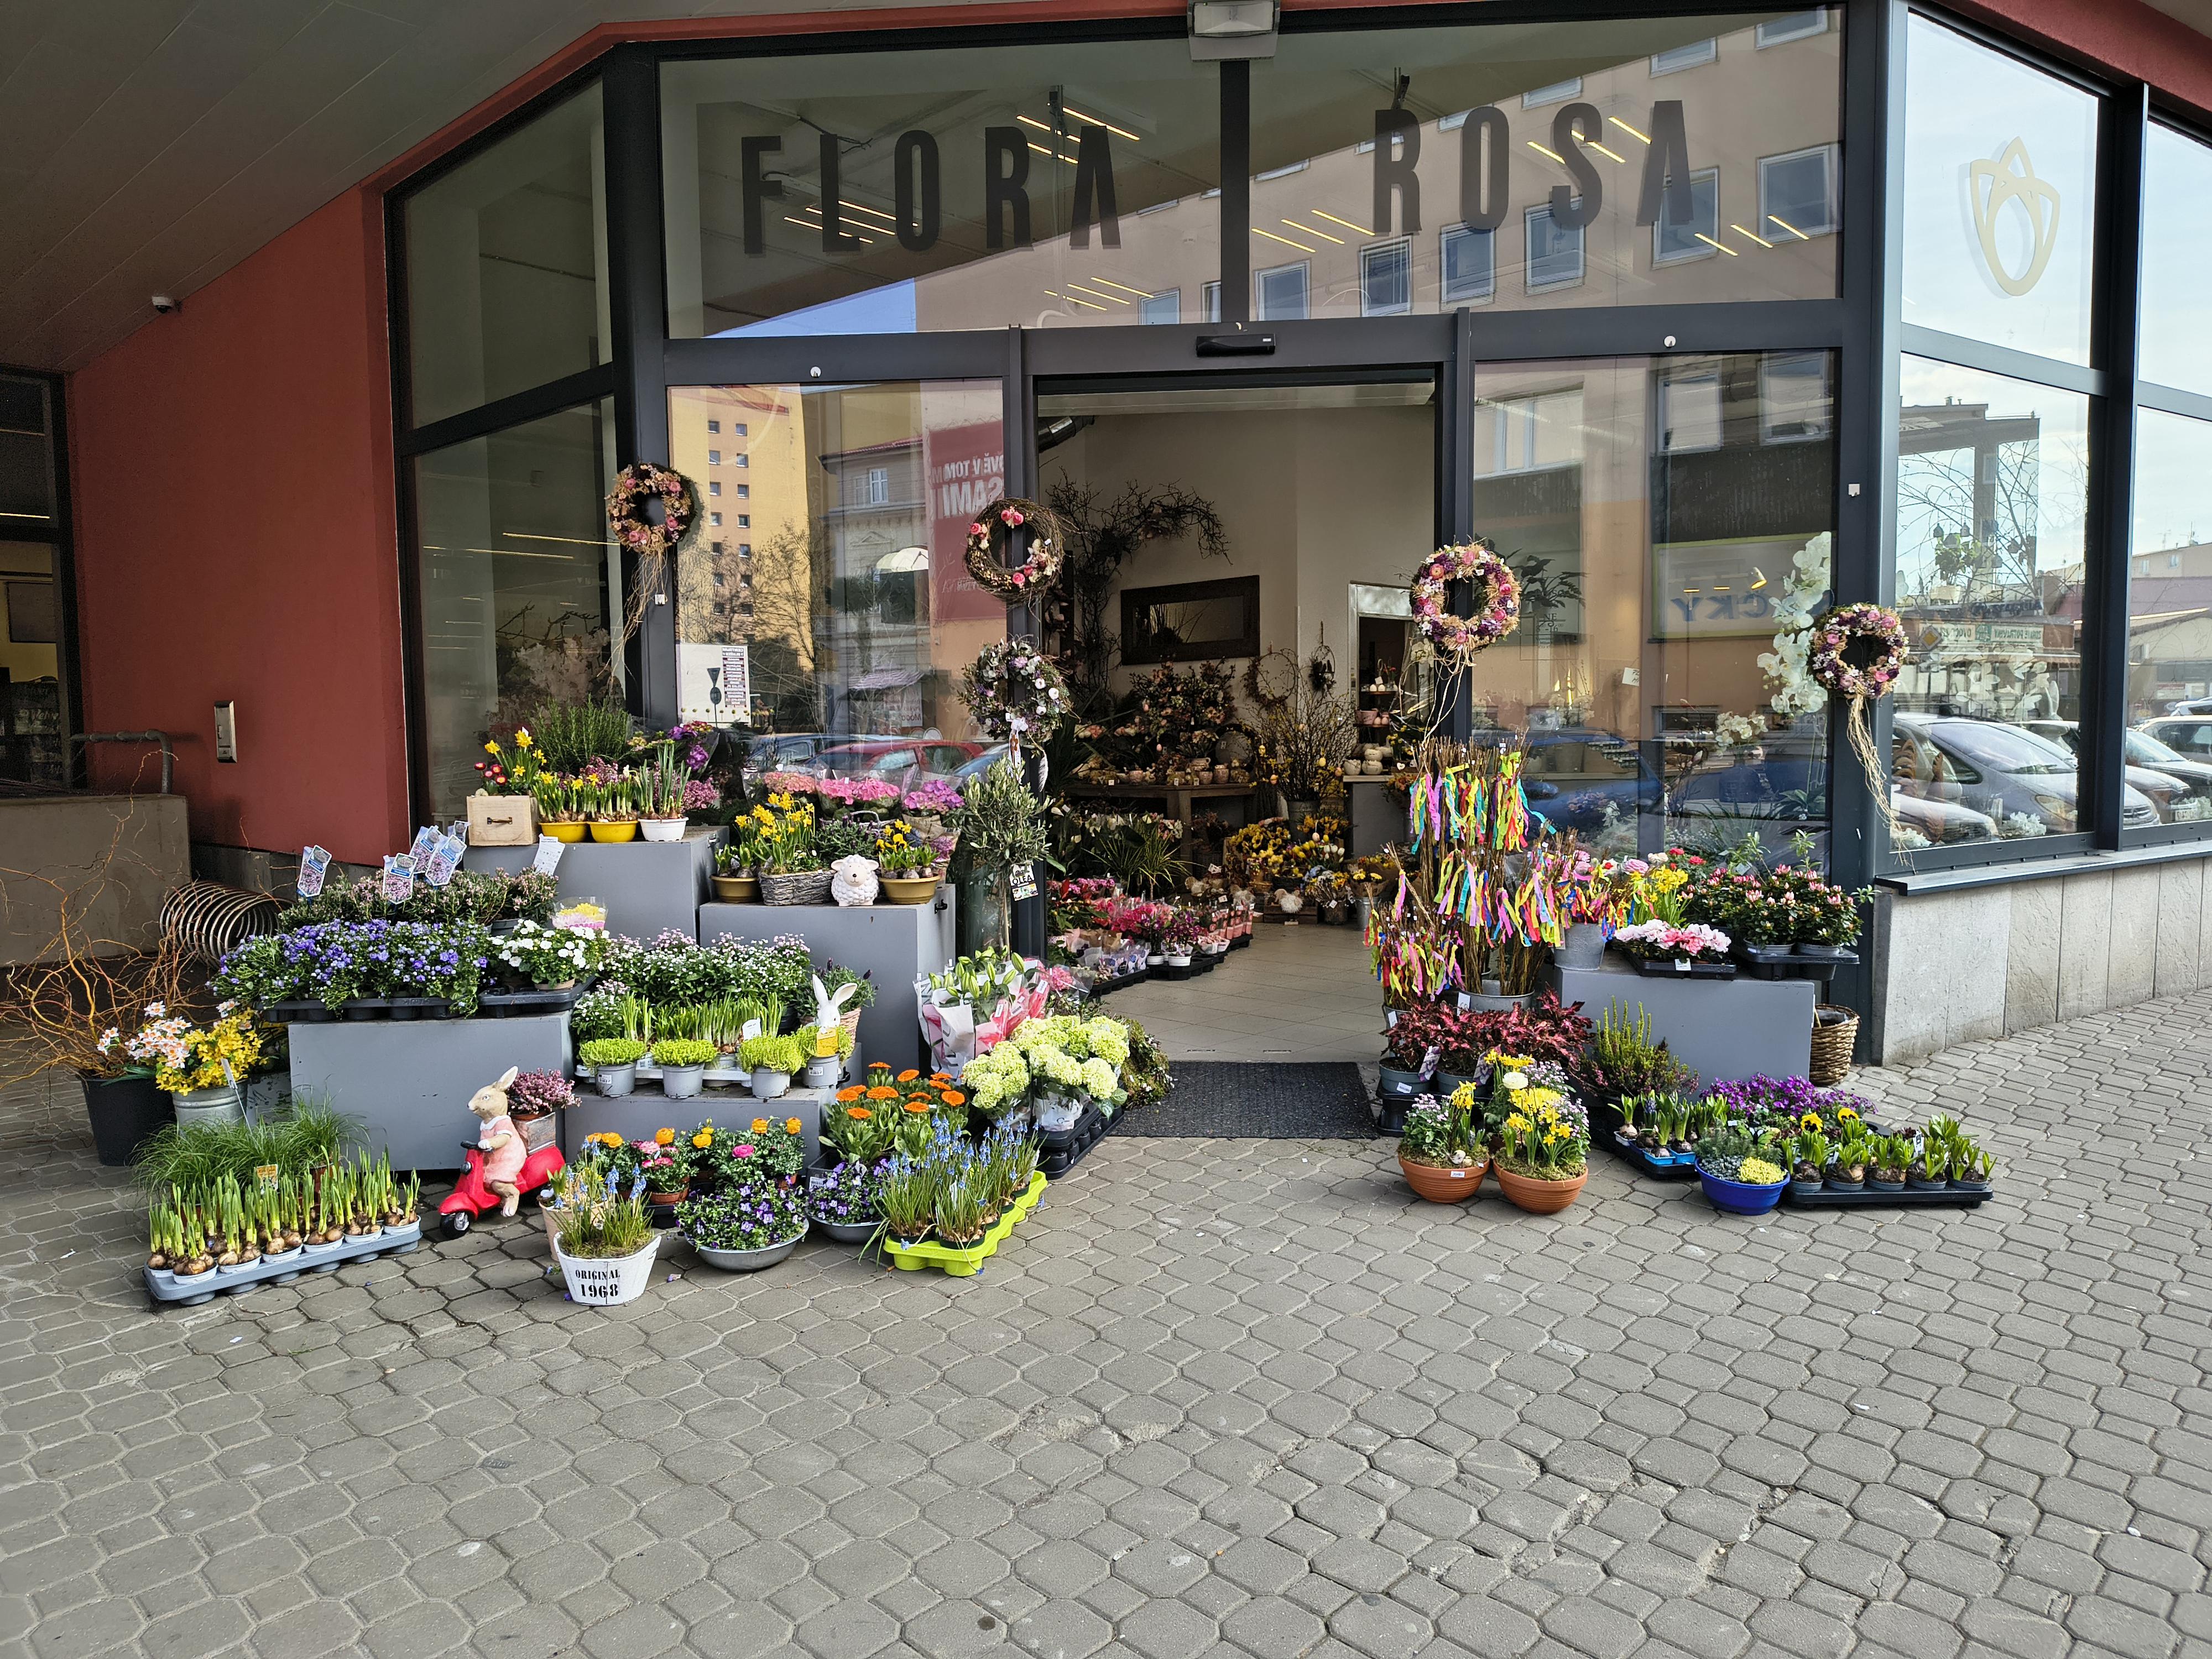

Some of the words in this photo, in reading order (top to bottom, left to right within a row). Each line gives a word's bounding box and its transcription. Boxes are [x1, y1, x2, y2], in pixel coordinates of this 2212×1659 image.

[741, 125, 1121, 254] FLORA
[1373, 100, 1694, 235] ROSA
[1013, 875, 1032, 885] OLEA
[576, 1269, 620, 1280] ORIGINAL
[581, 1284, 619, 1298] 1968
